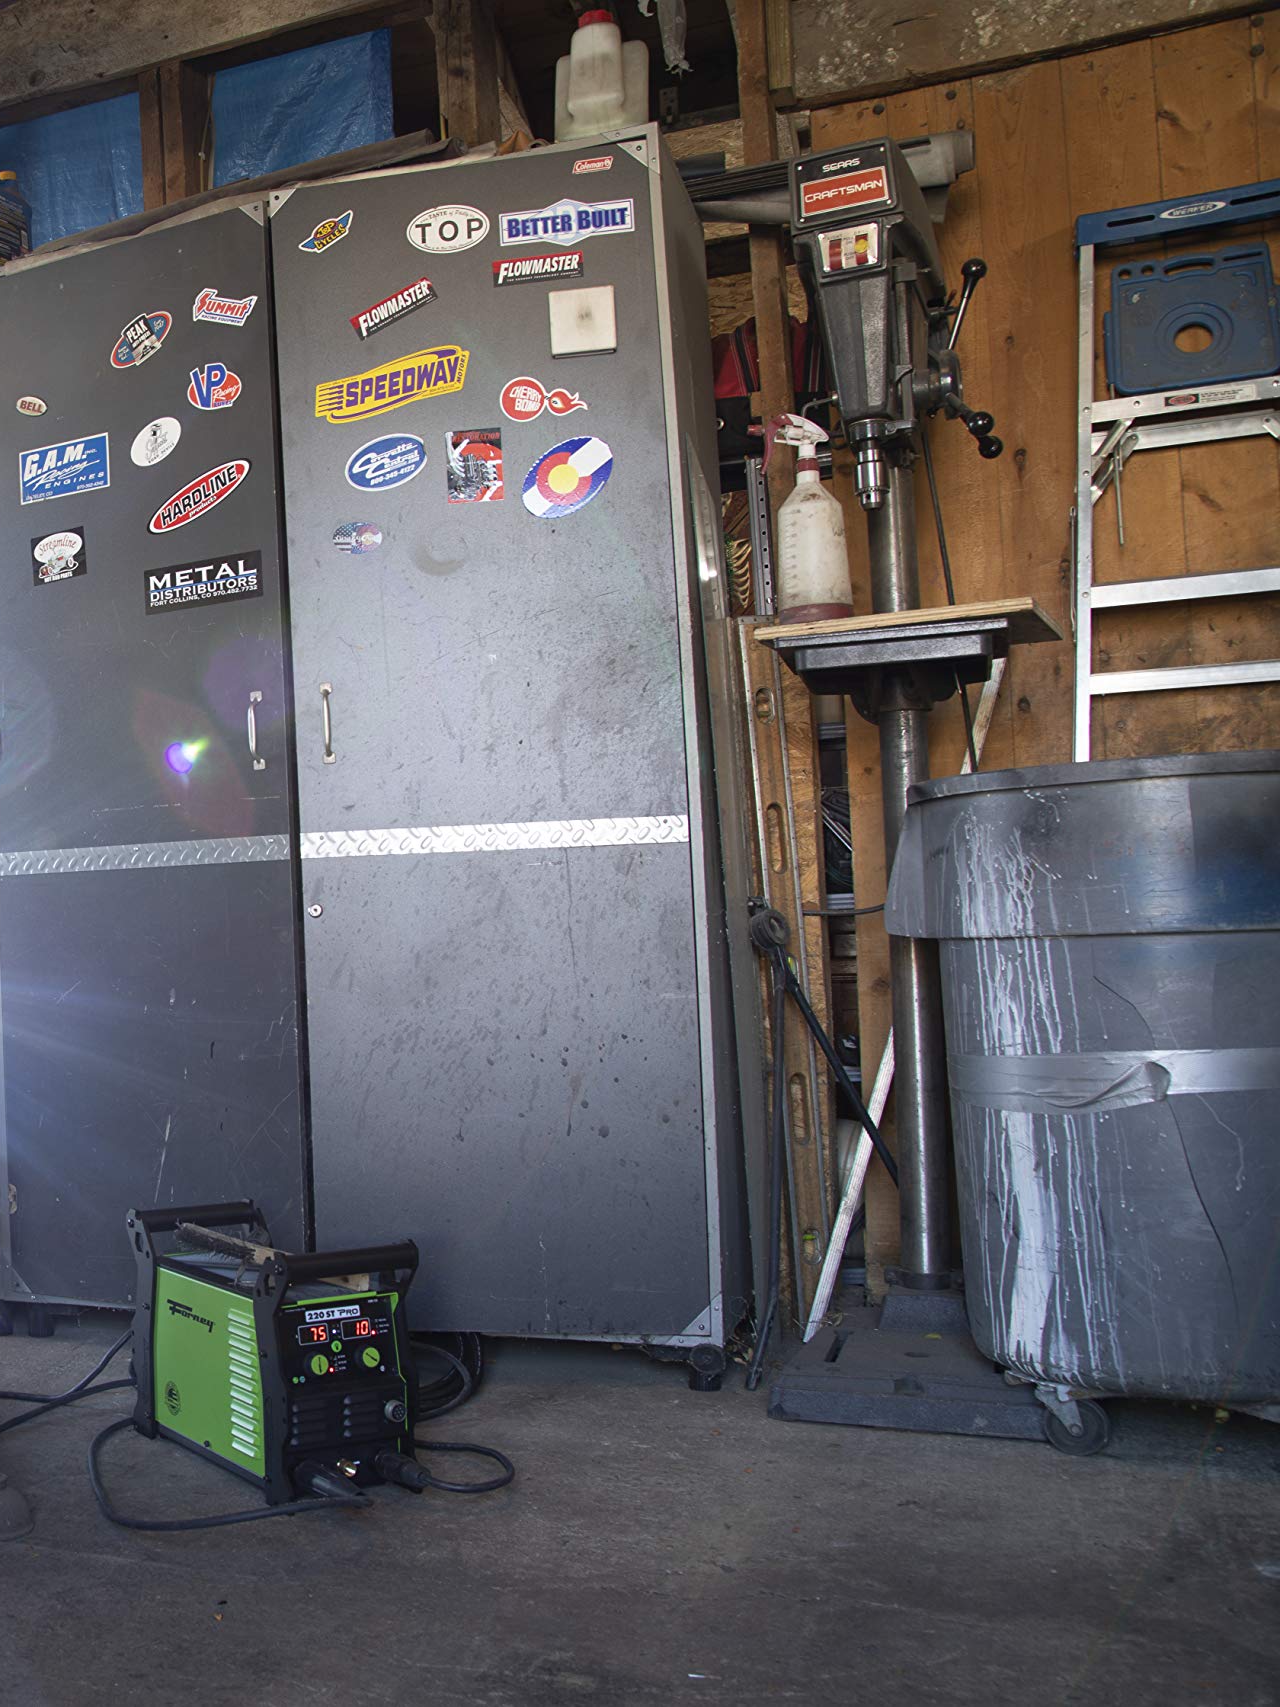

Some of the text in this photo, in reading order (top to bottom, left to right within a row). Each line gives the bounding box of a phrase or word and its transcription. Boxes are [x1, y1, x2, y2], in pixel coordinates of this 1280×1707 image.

[575, 158, 607, 172] Coleman
[822, 158, 860, 173] SEARS
[804, 179, 883, 203] CRAFTSMAN
[415, 217, 484, 244] TOP
[507, 207, 628, 239] BETTER BUILT
[313, 224, 347, 250] CYCLES
[497, 254, 580, 285] FLOWMASTER
[197, 292, 250, 317] SUMMIT
[358, 280, 431, 338] FLOWMASTER
[126, 318, 149, 344] PEAK
[456, 354, 467, 384] MOTORS
[191, 364, 227, 409] VP
[345, 356, 460, 408] SPEEDWAY
[509, 386, 541, 401] CHERRY
[20, 400, 43, 413] BELL
[514, 398, 541, 412] BOMB
[23, 443, 87, 482] G.A.M.
[44, 471, 105, 489] ENGINES
[160, 465, 238, 529] HARDLINE
[189, 495, 217, 519] products
[39, 534, 77, 557] Streamline
[149, 559, 258, 592] METAL
[150, 575, 258, 602] DISTRIBUTORS
[150, 599, 168, 608] FORT
[201, 591, 212, 599] CO
[167, 1298, 214, 1333] Forney
[307, 1307, 359, 1321] 220 ST PRO
[310, 1326, 327, 1341] 75
[355, 1320, 369, 1335] 10
